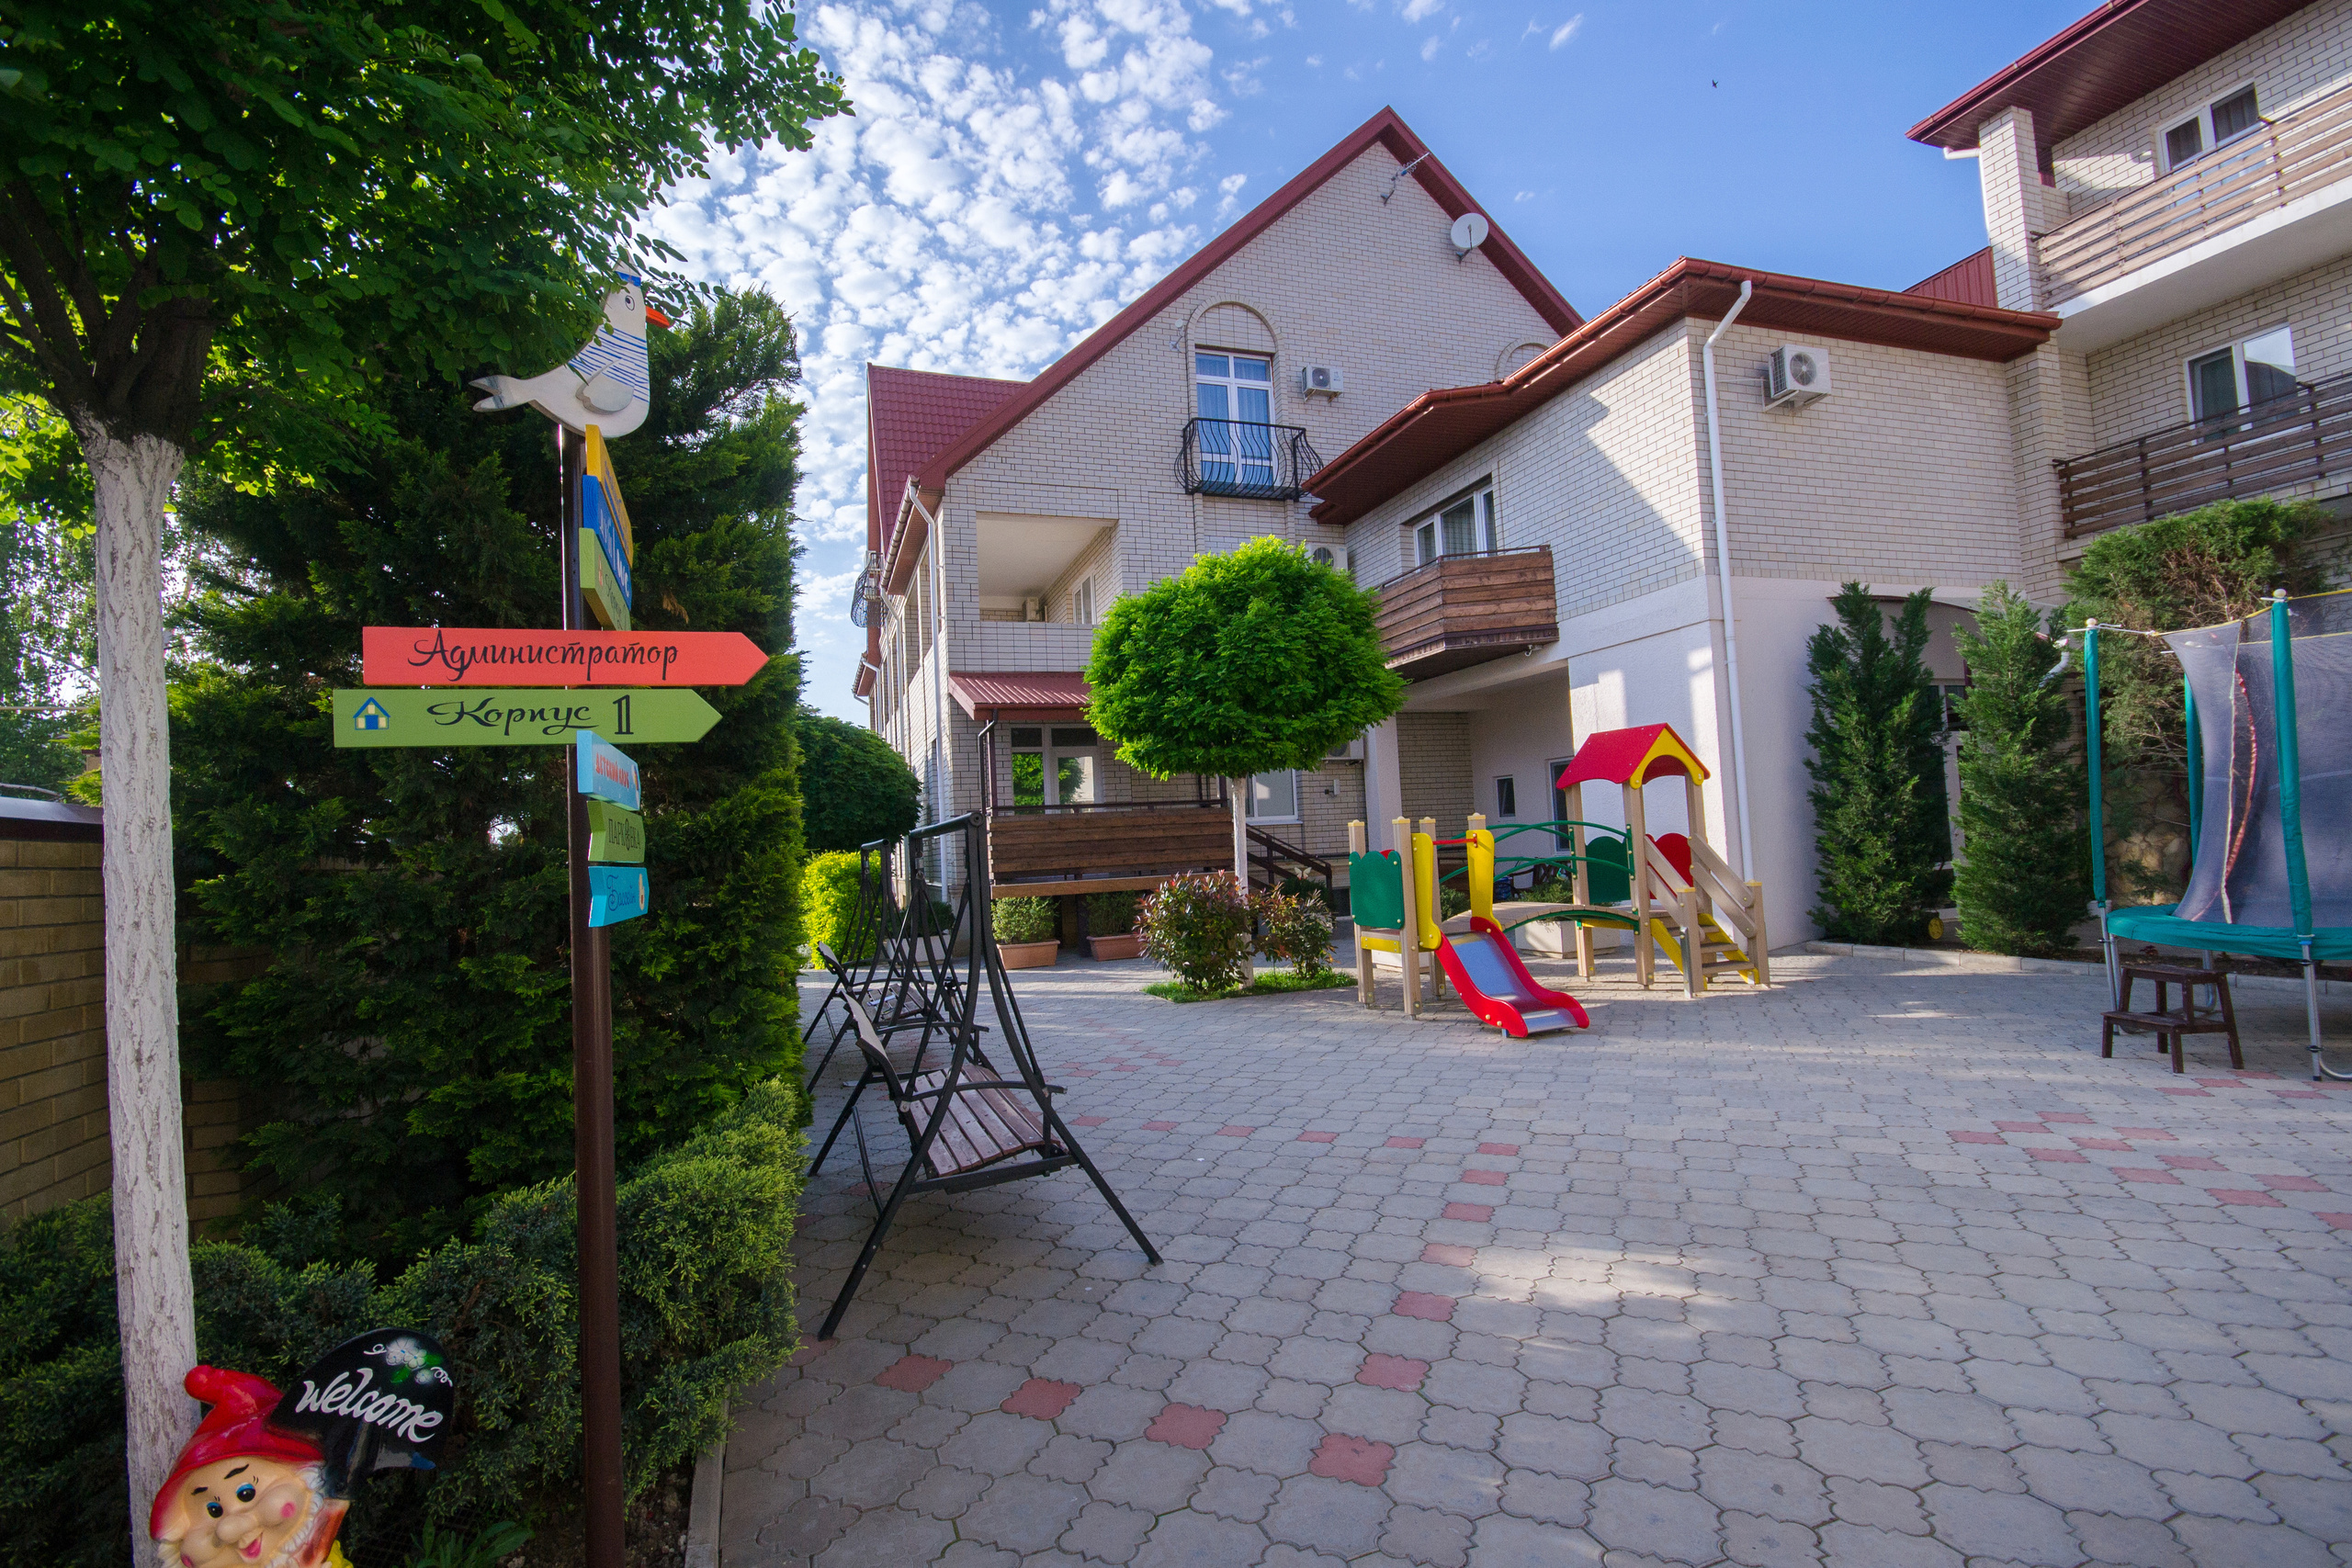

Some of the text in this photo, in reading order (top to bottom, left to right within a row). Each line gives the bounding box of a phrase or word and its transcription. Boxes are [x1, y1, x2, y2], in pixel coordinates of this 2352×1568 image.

[407, 628, 678, 682] Администратор
[426, 694, 634, 737] Корпус 1
[608, 818, 641, 851] ПАРКОВКА
